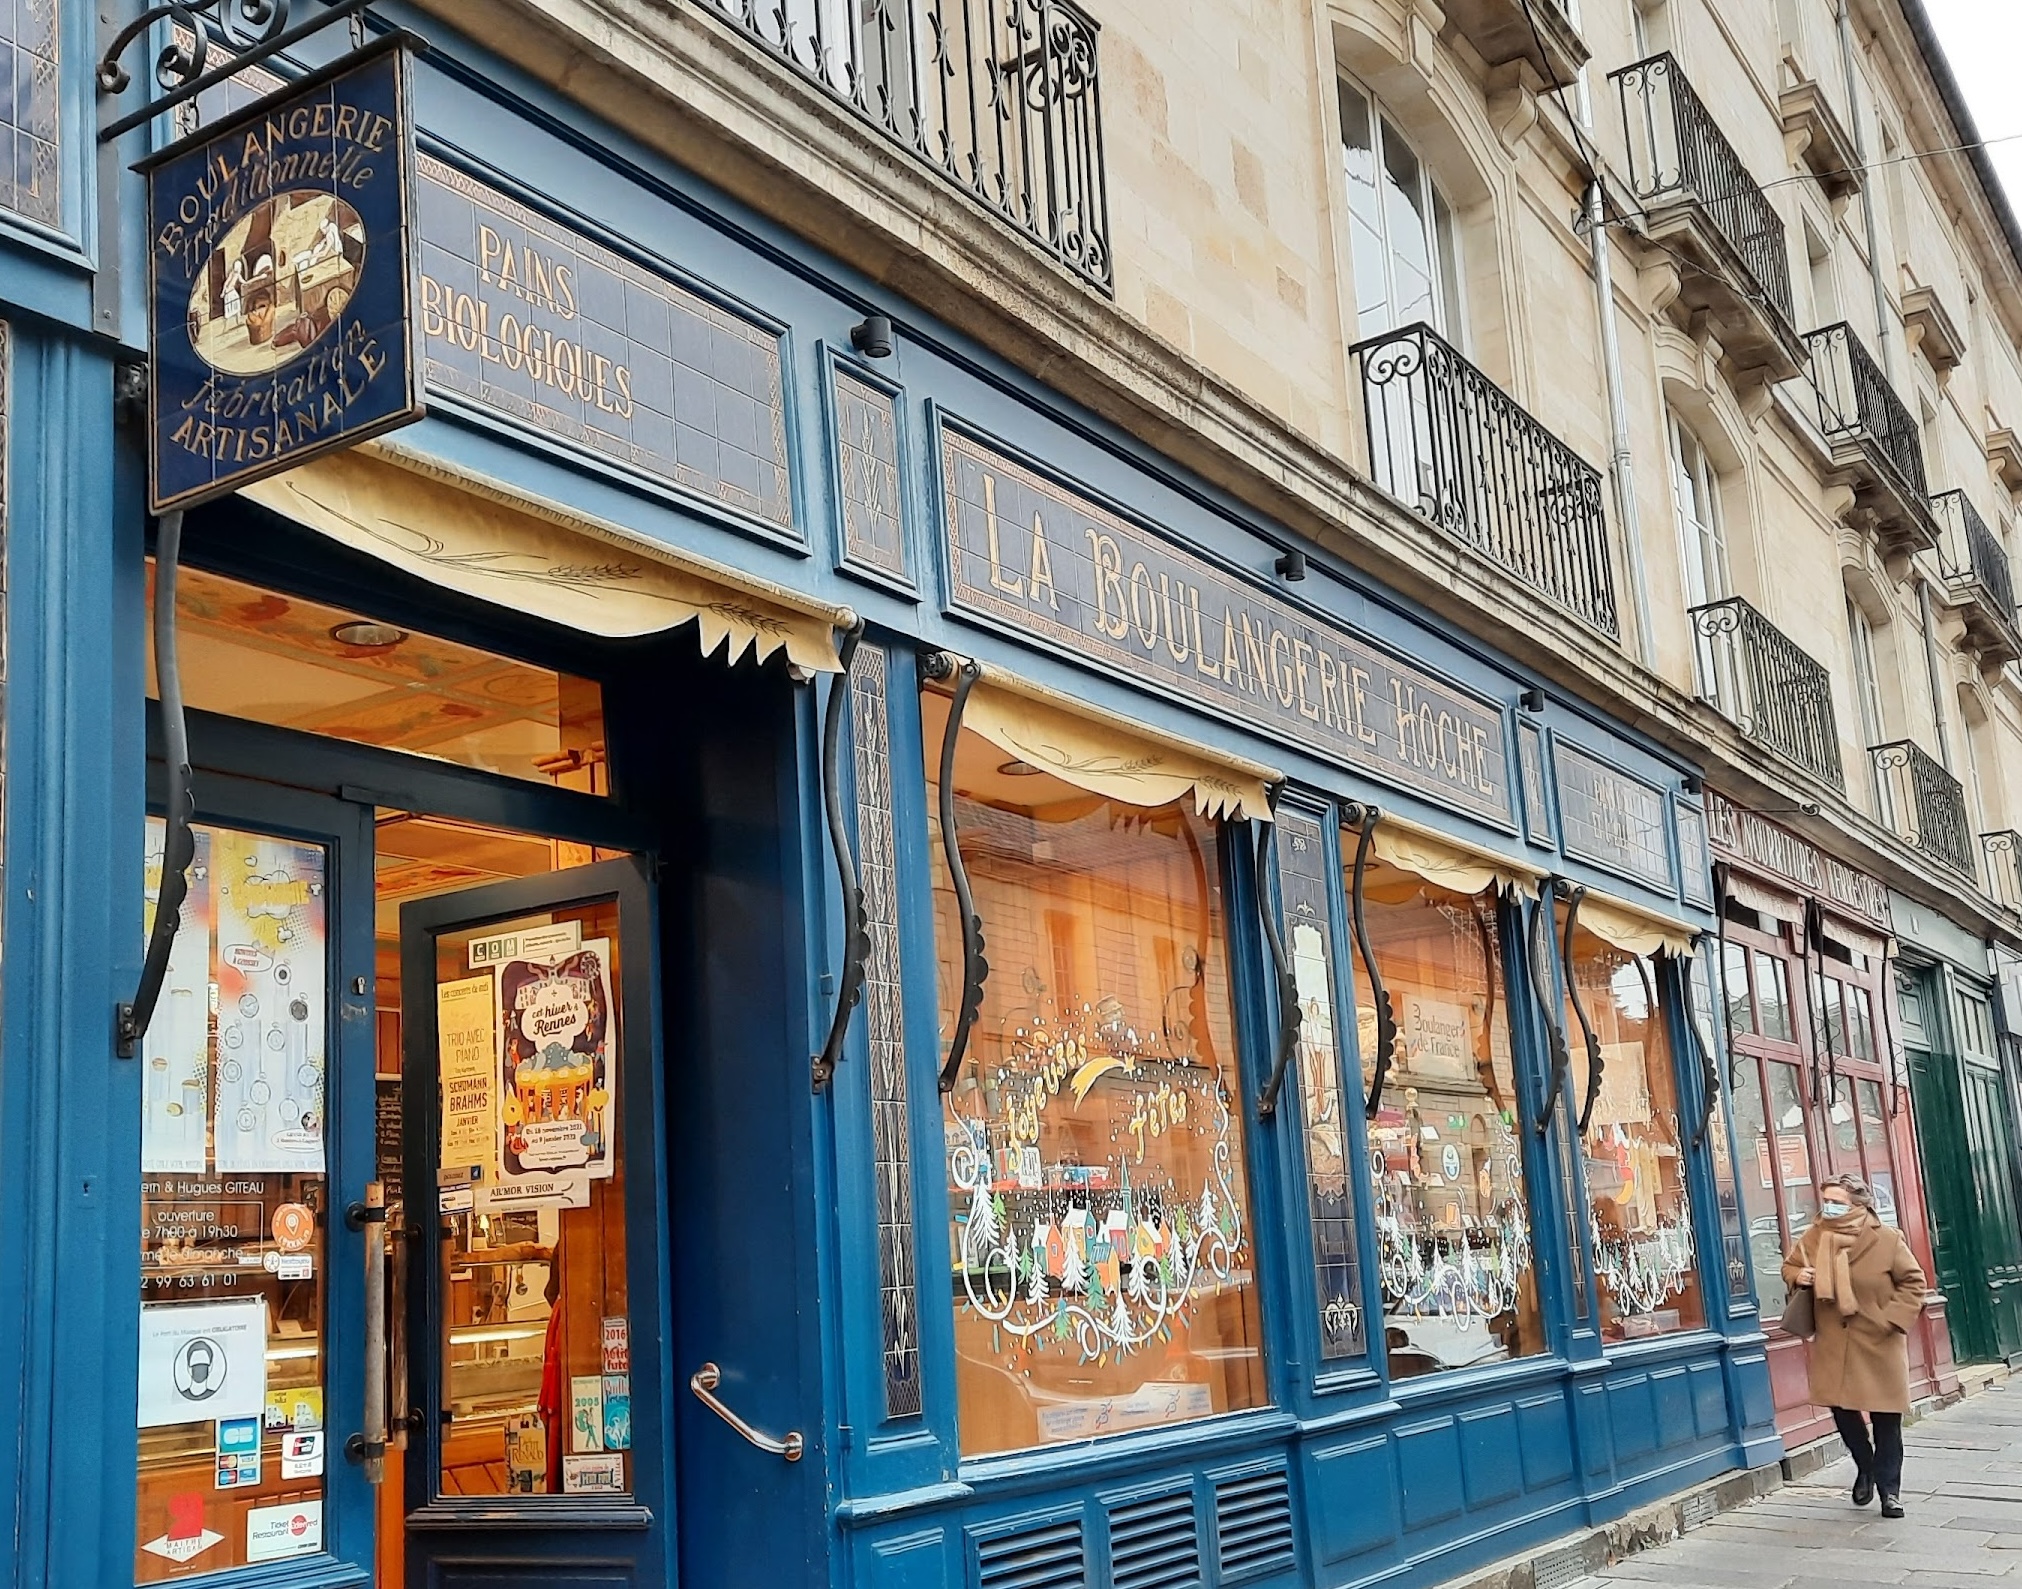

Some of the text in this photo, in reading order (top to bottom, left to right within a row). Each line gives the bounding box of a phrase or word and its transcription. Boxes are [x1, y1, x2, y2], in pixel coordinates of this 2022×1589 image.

[158, 104, 392, 256] BOULANGERIE
[479, 223, 575, 320] PAINS
[421, 274, 633, 419] BIOLOGIQUES
[169, 339, 386, 462] ARTISANALE
[983, 472, 1494, 796] LA BOULANGERIE HOCHE
[1708, 791, 1737, 849] LES
[1741, 812, 1823, 890] NOURRITURES
[1825, 857, 1890, 924] TERRESTRES
[545, 1002, 572, 1018] hiver
[533, 1014, 576, 1036] Rennes
[446, 1028, 485, 1047] TRIO AVEC
[456, 1046, 480, 1063] PIANO
[1431, 1037, 1460, 1058] France
[450, 1092, 488, 1112] BRAHMS
[164, 1181, 174, 1193] &
[177, 1181, 222, 1197] Hugues
[225, 1181, 264, 1194] GITEAU
[525, 1183, 554, 1194] VISION
[157, 1209, 215, 1222] ouverture
[155, 1225, 184, 1239] 7h00
[188, 1224, 197, 1238] à
[202, 1225, 238, 1238] 19h30
[182, 1247, 243, 1260] dimanche
[156, 1275, 172, 1288] 99
[179, 1274, 195, 1288] 63
[201, 1274, 215, 1287] 61
[223, 1273, 237, 1286] 01
[605, 1328, 626, 1341] 2016
[574, 1397, 600, 1407] 2005
[271, 1520, 289, 1530] Ticket
[252, 1528, 289, 1540] Restaurant
